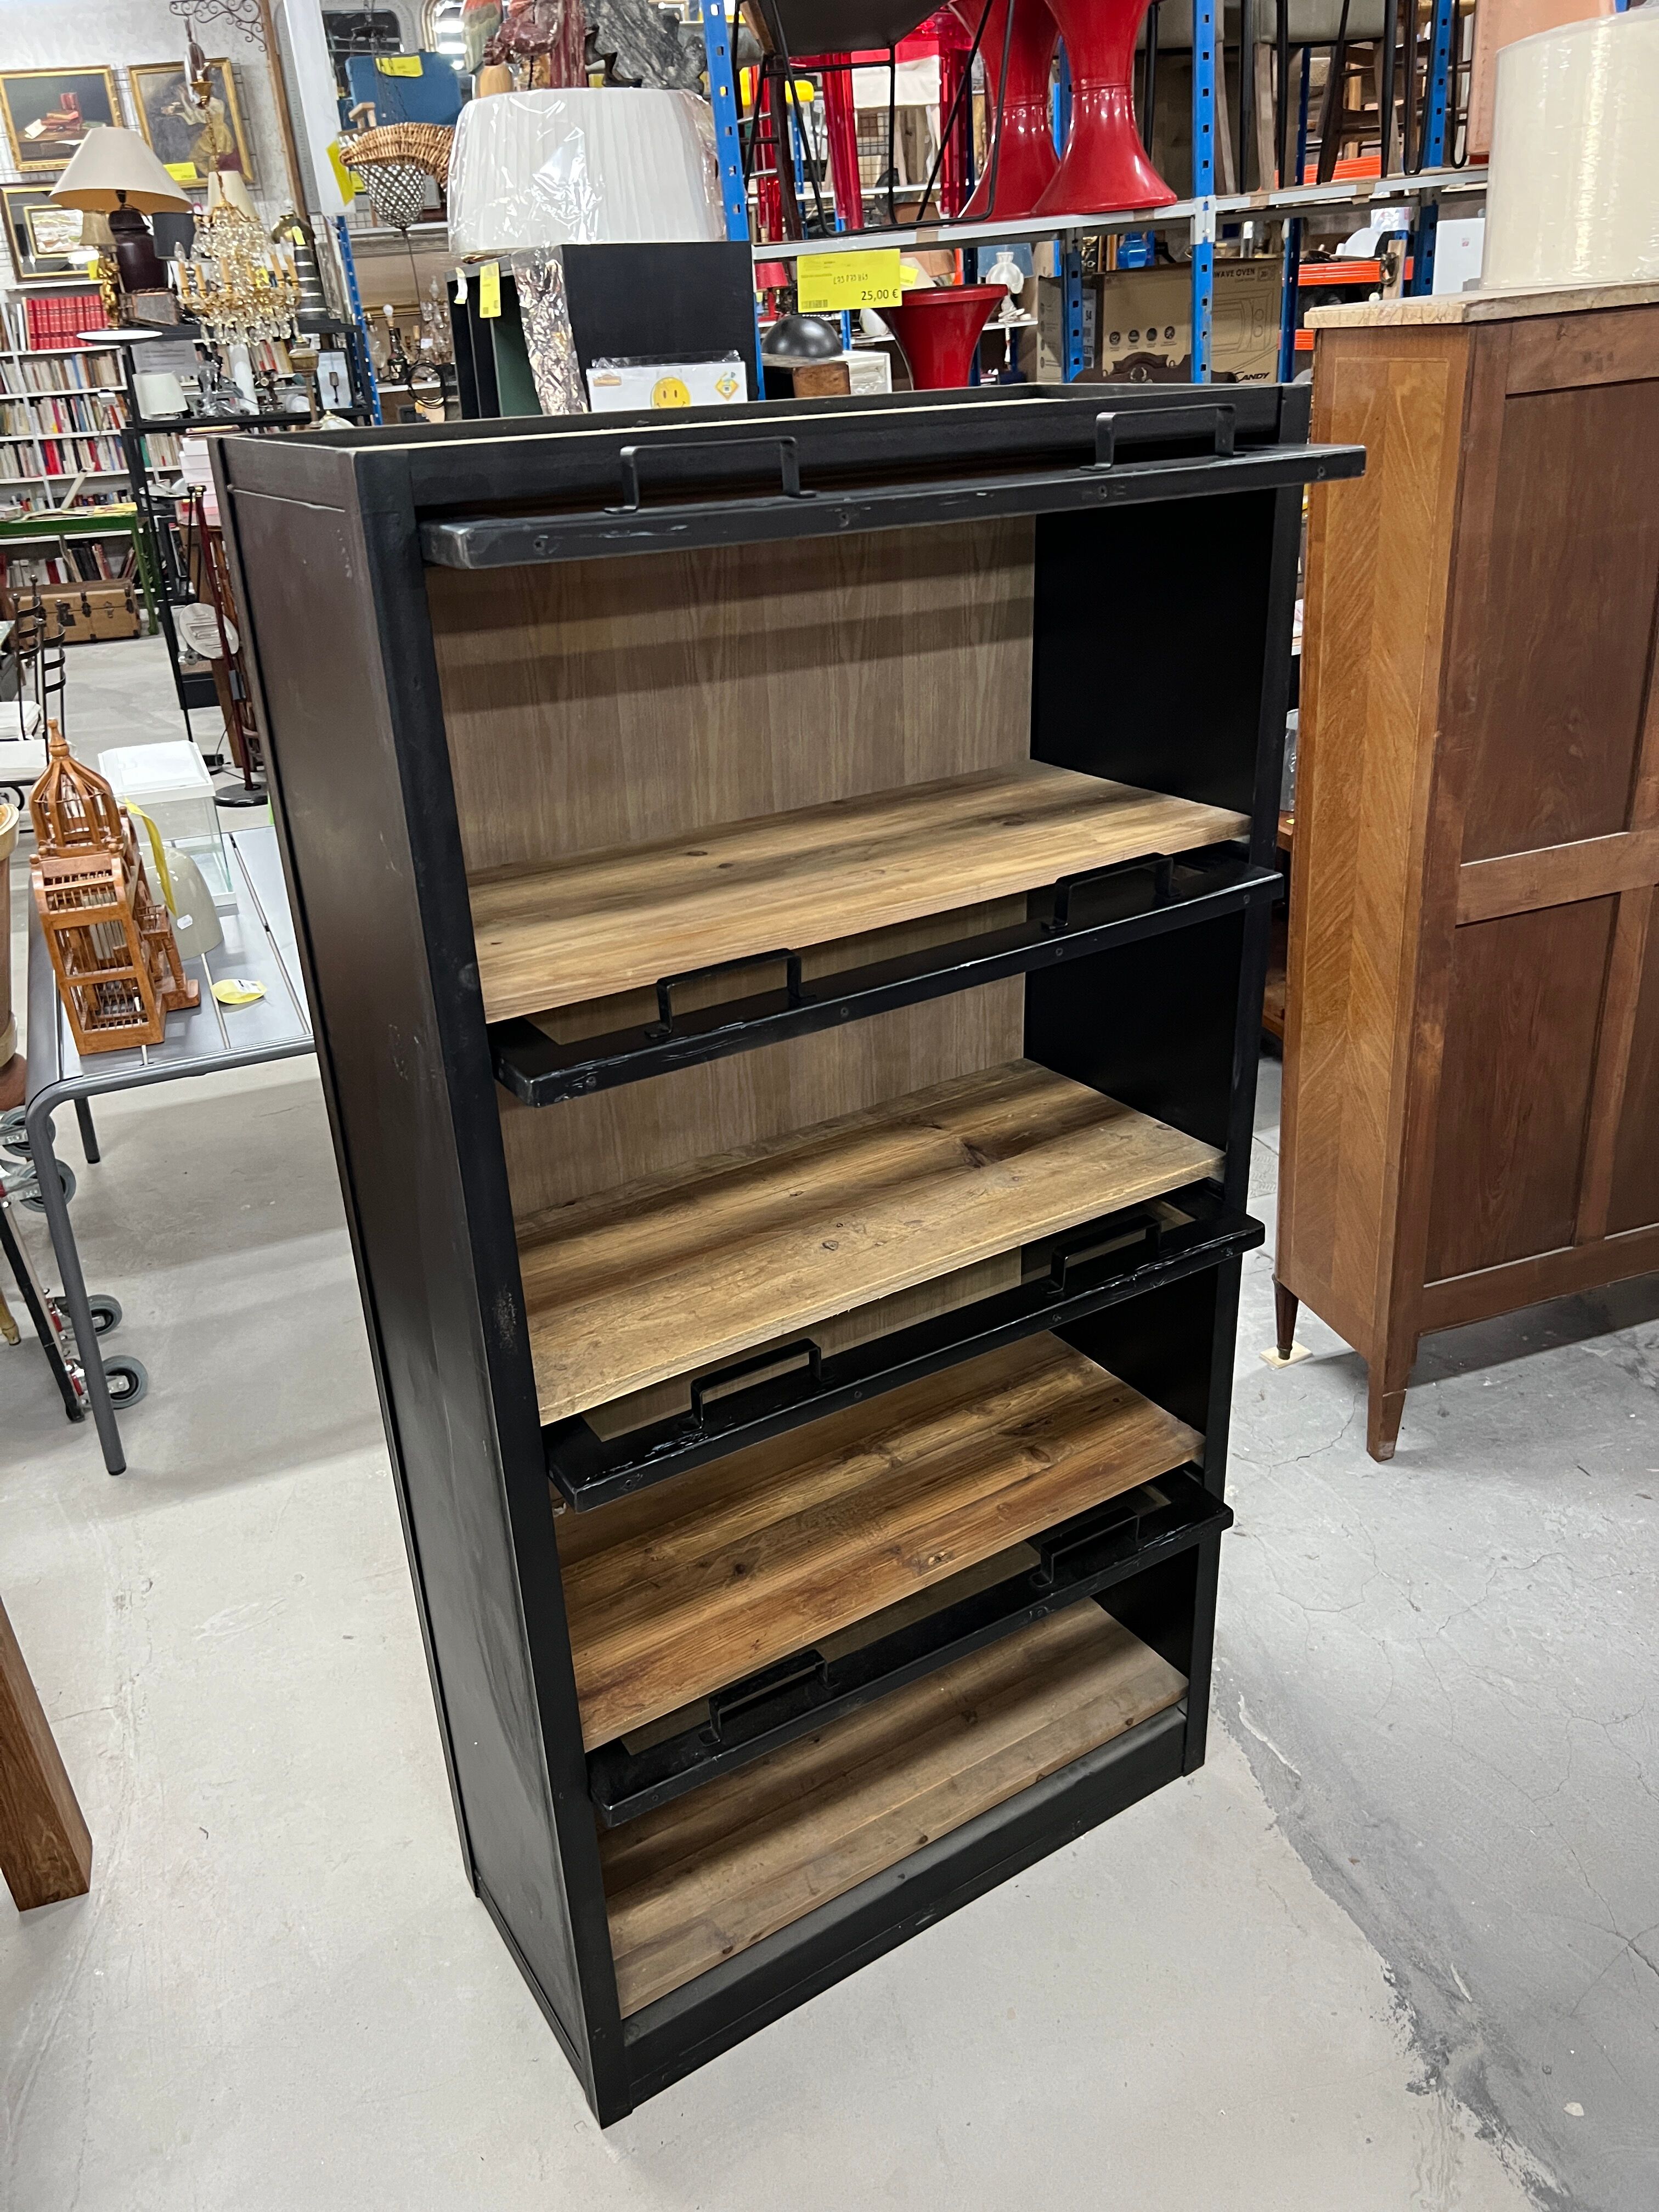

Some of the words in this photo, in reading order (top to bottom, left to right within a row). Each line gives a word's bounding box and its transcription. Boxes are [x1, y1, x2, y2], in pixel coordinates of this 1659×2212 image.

[1235, 268, 1255, 276] OVEN
[861, 289, 889, 302] 25,00
[892, 289, 899, 298] €
